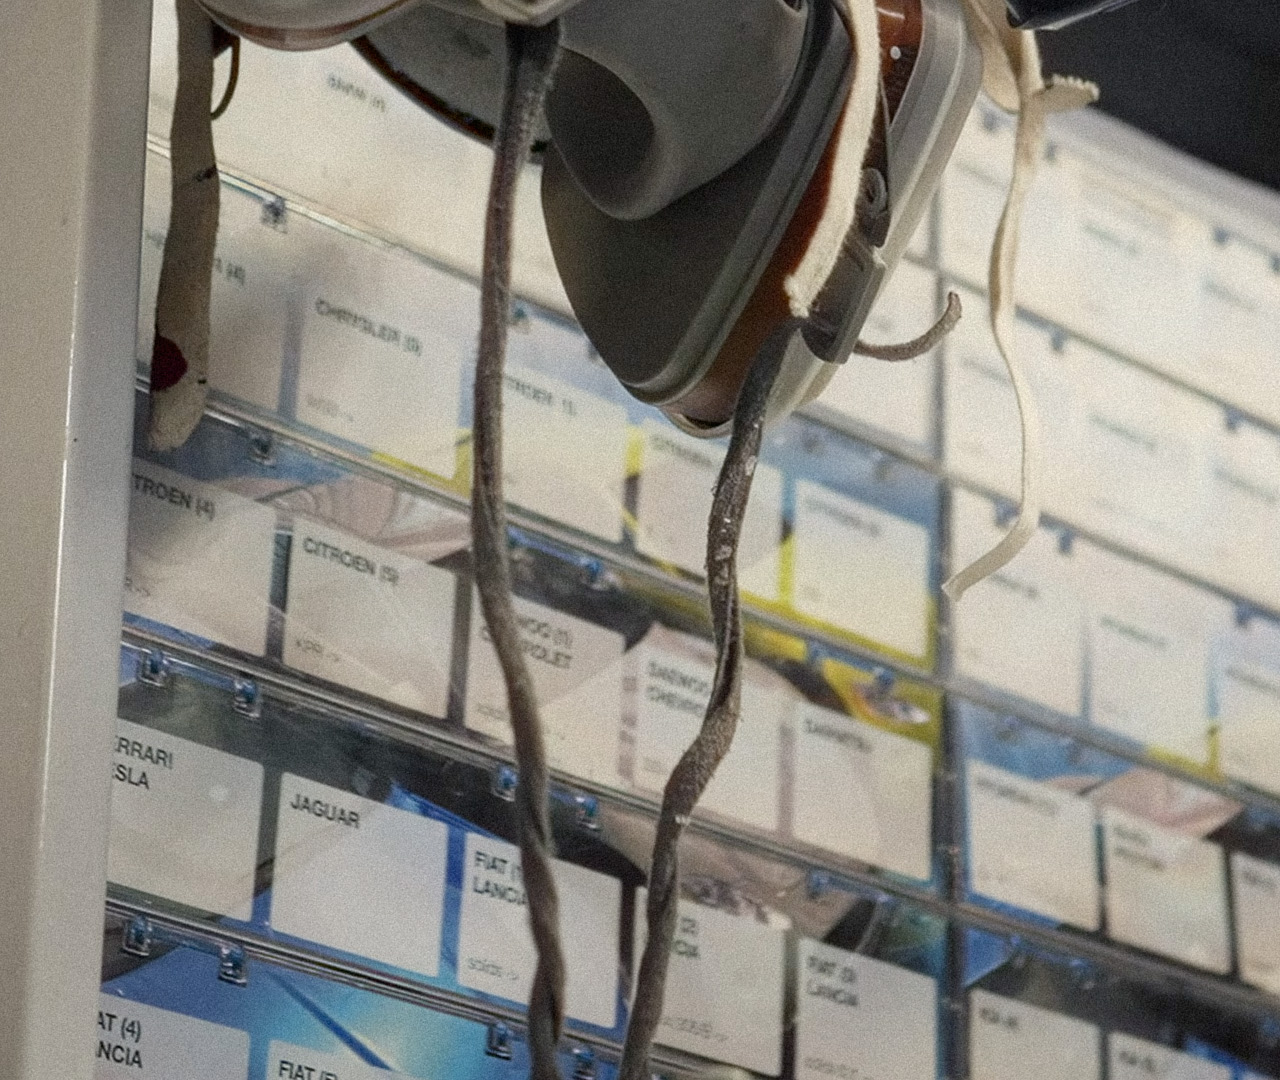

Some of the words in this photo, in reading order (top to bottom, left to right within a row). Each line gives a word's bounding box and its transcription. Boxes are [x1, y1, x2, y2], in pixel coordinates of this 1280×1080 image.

[302, 537, 376, 580] CITROEN
[112, 762, 150, 790] SLA
[290, 794, 360, 829] JAGUAR
[474, 850, 508, 875] FIAT
[121, 1017, 141, 1043] (4)
